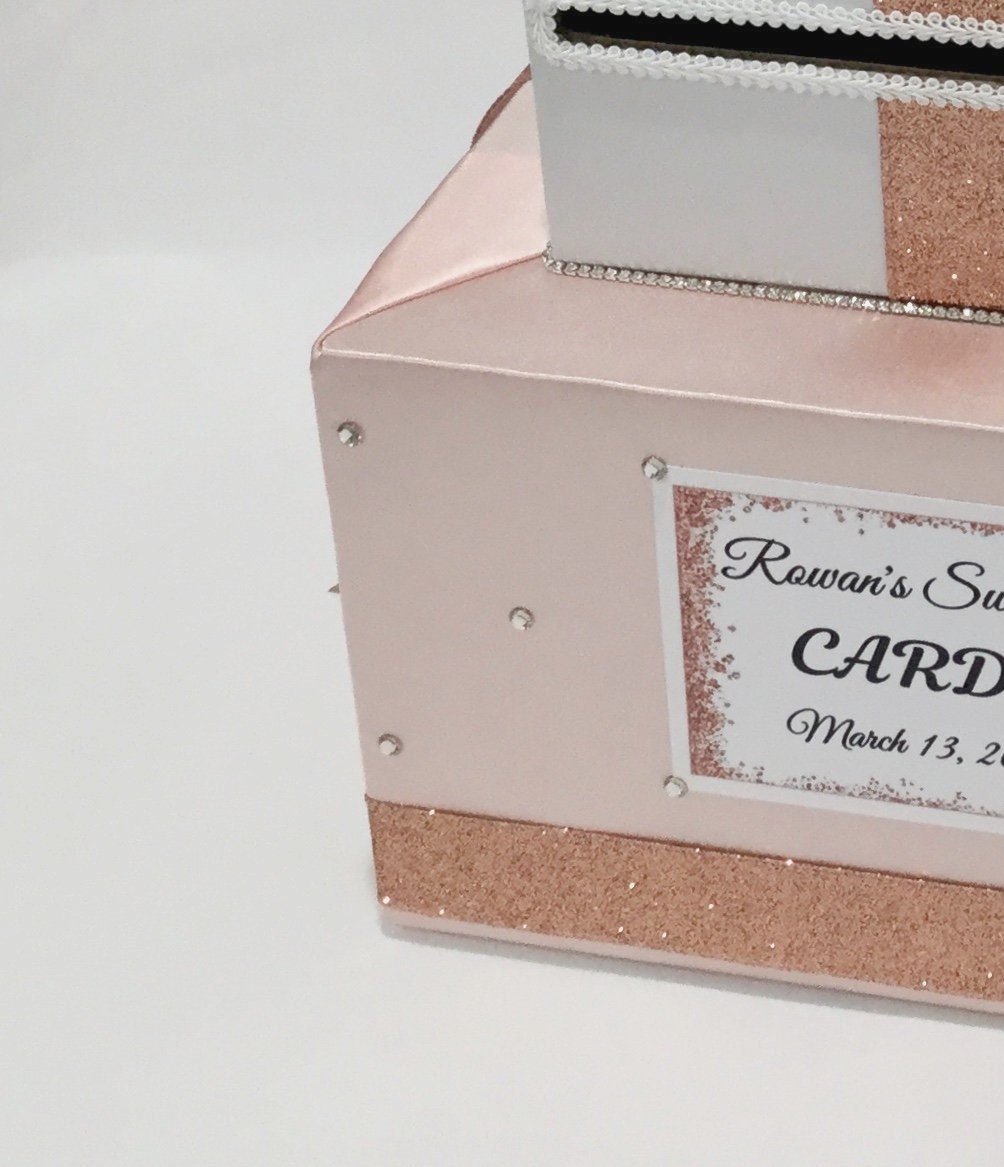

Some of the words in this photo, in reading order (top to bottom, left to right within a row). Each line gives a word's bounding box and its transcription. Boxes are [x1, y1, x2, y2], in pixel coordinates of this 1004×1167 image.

[721, 537, 913, 599] Rowan's
[786, 708, 909, 754] March
[920, 734, 964, 765] 13,
